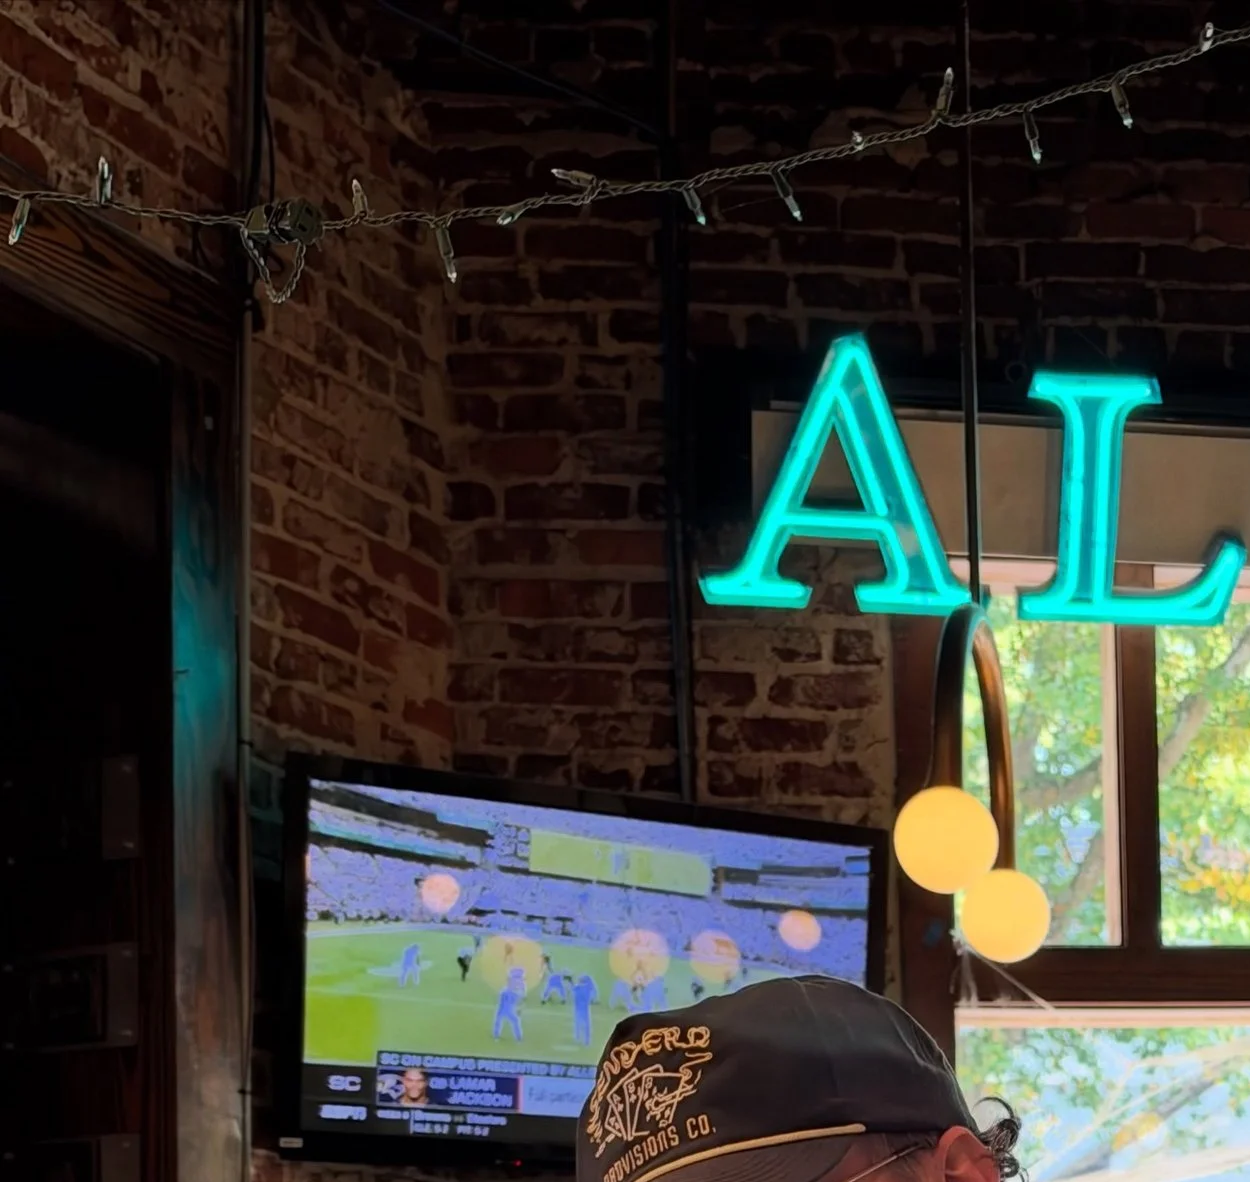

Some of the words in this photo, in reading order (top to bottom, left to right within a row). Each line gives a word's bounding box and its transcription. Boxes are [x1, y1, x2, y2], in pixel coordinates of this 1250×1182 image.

[327, 1074, 362, 1092] SC
[450, 1075, 496, 1092] LAMAR
[447, 1091, 513, 1108] JACKSON
